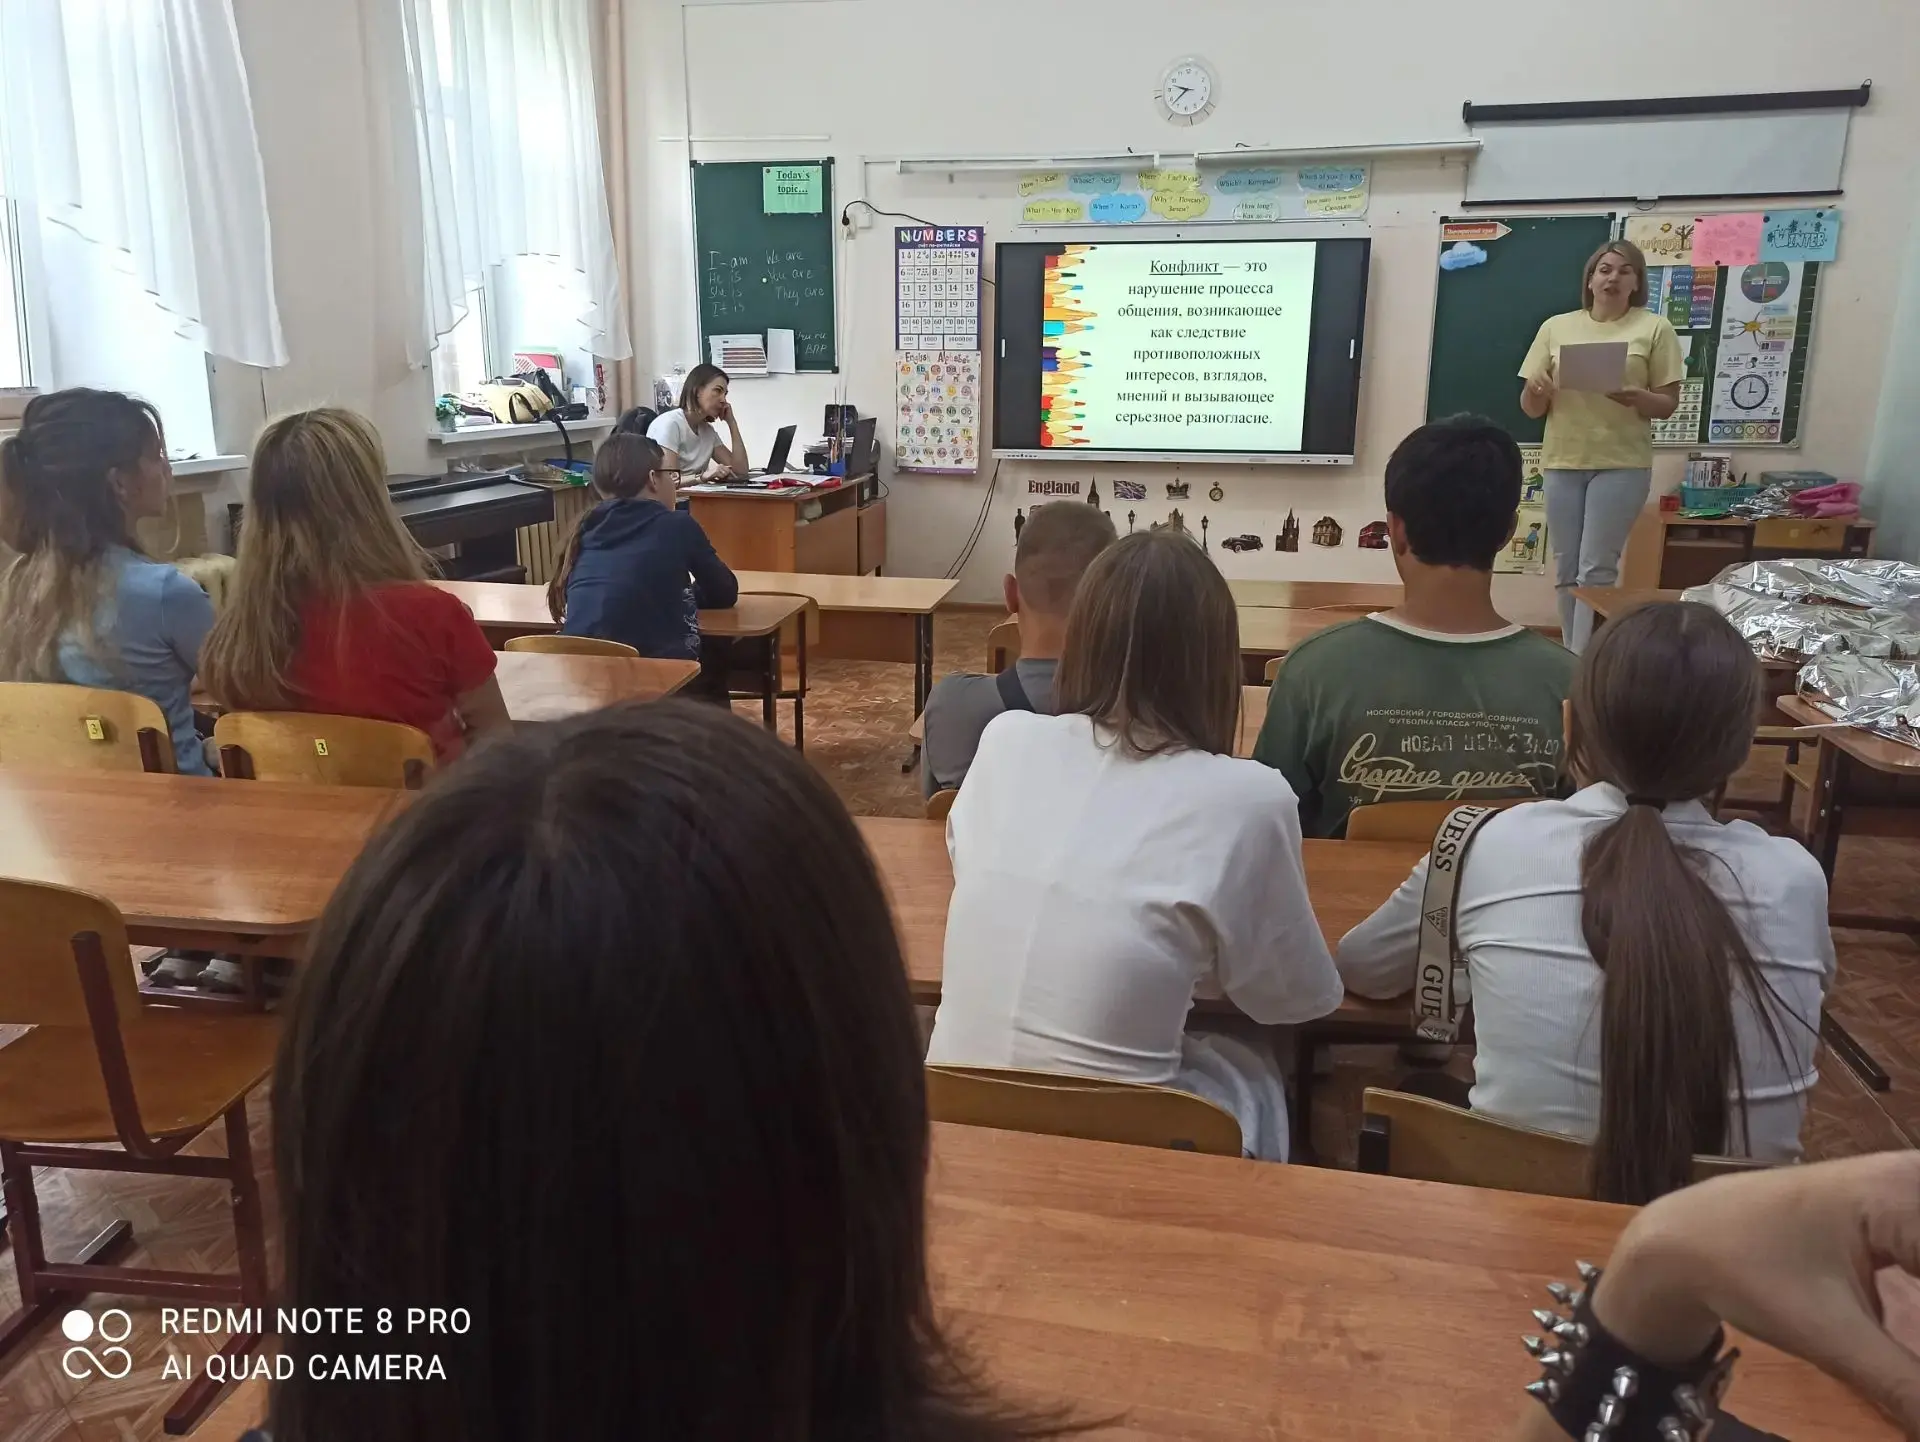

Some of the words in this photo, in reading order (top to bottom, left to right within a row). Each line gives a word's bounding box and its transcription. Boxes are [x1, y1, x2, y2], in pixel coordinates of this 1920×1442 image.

[776, 170, 810, 180] Today's
[900, 229, 977, 242] NUMBERS
[1772, 230, 1826, 249] WINTER
[1150, 259, 1220, 275] Конфликт
[1244, 260, 1268, 273] это
[1128, 283, 1205, 298] нарушение
[1209, 283, 1274, 297] процесса
[1117, 303, 1183, 319] общения,
[1187, 304, 1283, 318] возникающее
[1150, 326, 1172, 338] как
[1177, 326, 1247, 340] следствие
[1133, 349, 1261, 363] противоположных
[1125, 370, 1200, 385] интересов,
[1203, 370, 1268, 385] взглядов,
[1116, 388, 1168, 403] мнений
[1171, 391, 1181, 402] и
[1184, 391, 1275, 405] вызывающее
[1115, 411, 1183, 425] серьезное
[1186, 412, 1273, 426] разногласие.
[1028, 480, 1080, 494] England
[1366, 708, 1424, 717] МОСКОВСКИЙ
[1432, 710, 1484, 719] ГОРОДСКОЙ
[1488, 714, 1539, 725] СОВНАРХОЗ
[1388, 718, 1434, 726] ФУТБОЛКА
[1436, 719, 1470, 727] КЛАССА
